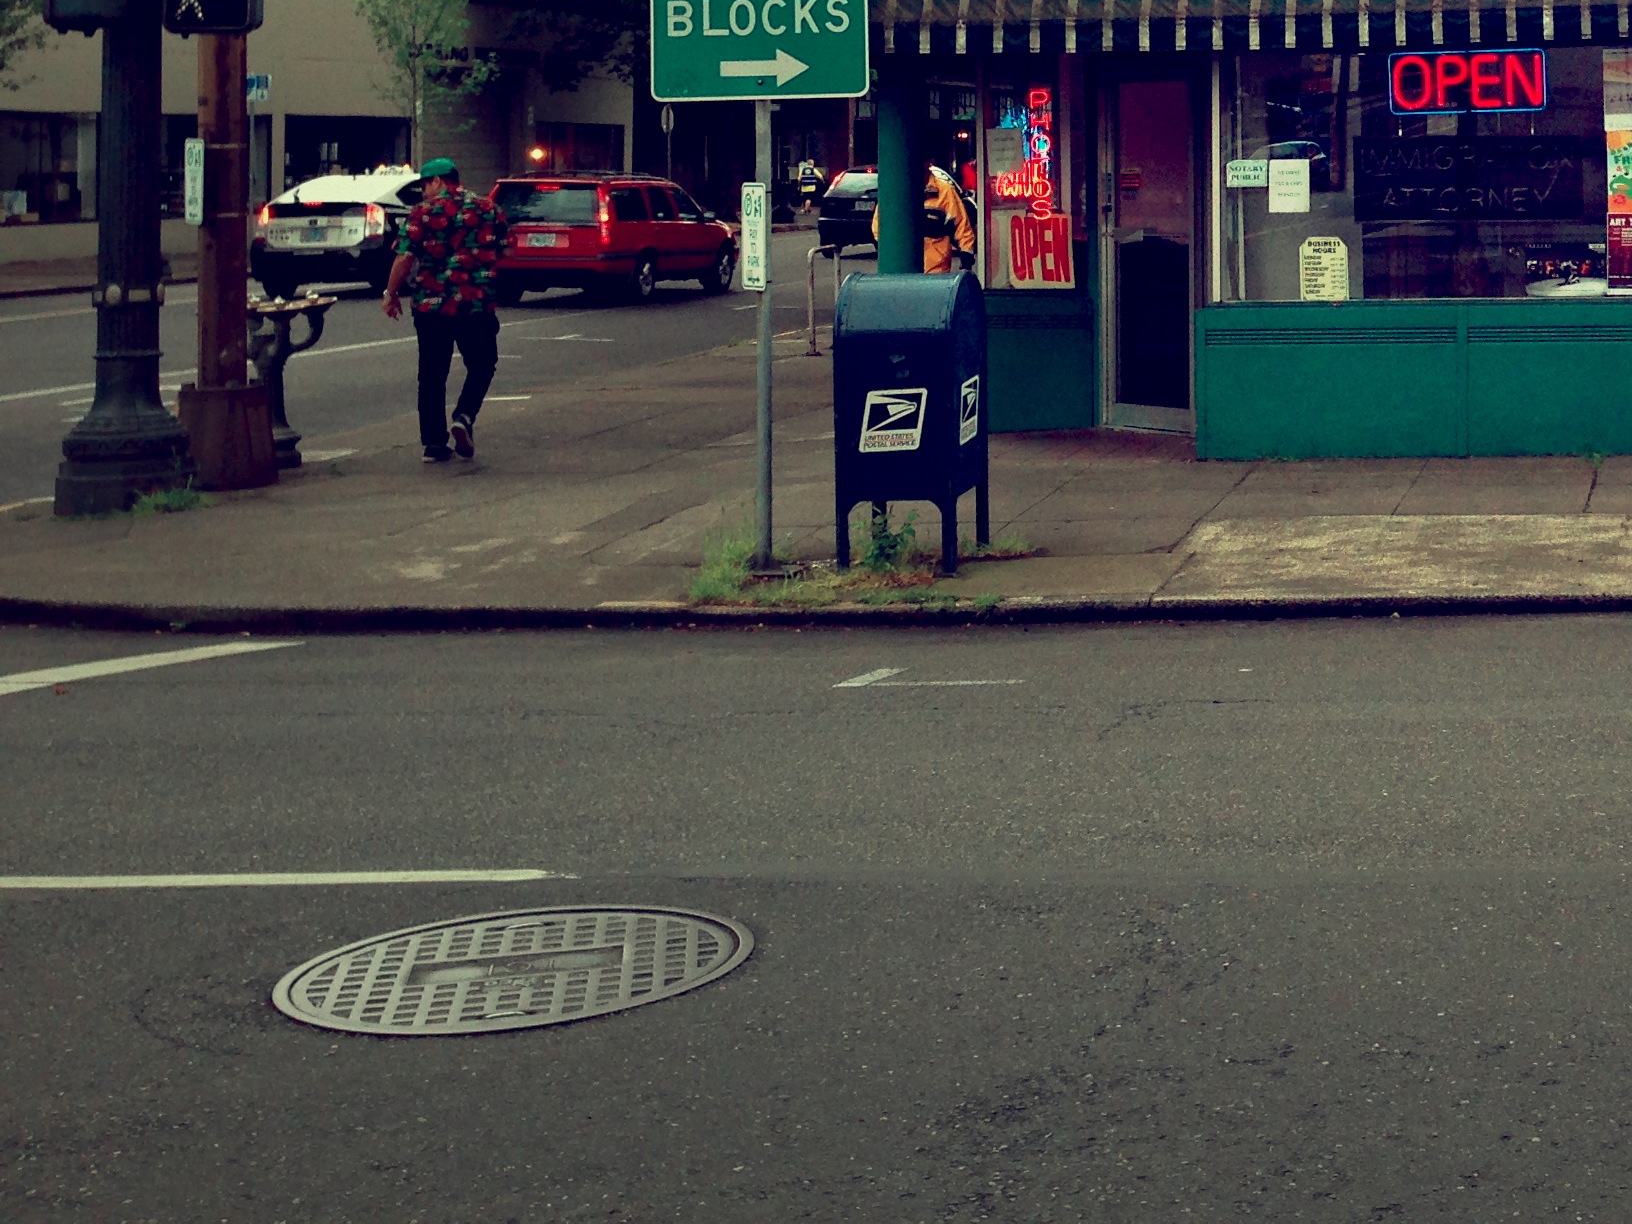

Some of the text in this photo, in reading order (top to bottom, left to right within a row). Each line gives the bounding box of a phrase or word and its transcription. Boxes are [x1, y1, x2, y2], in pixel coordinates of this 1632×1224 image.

[1392, 53, 1543, 110] OPEN
[1030, 90, 1052, 221] PHOTOS
[1229, 165, 1265, 173] NOTARY
[1382, 185, 1555, 213] ATTORNEY
[1609, 218, 1627, 227] ART
[1011, 214, 1072, 284] OPEN
[1307, 240, 1341, 248] BUSINESS
[865, 432, 914, 442] UNITED STATES
[864, 440, 888, 450] POSTAL
